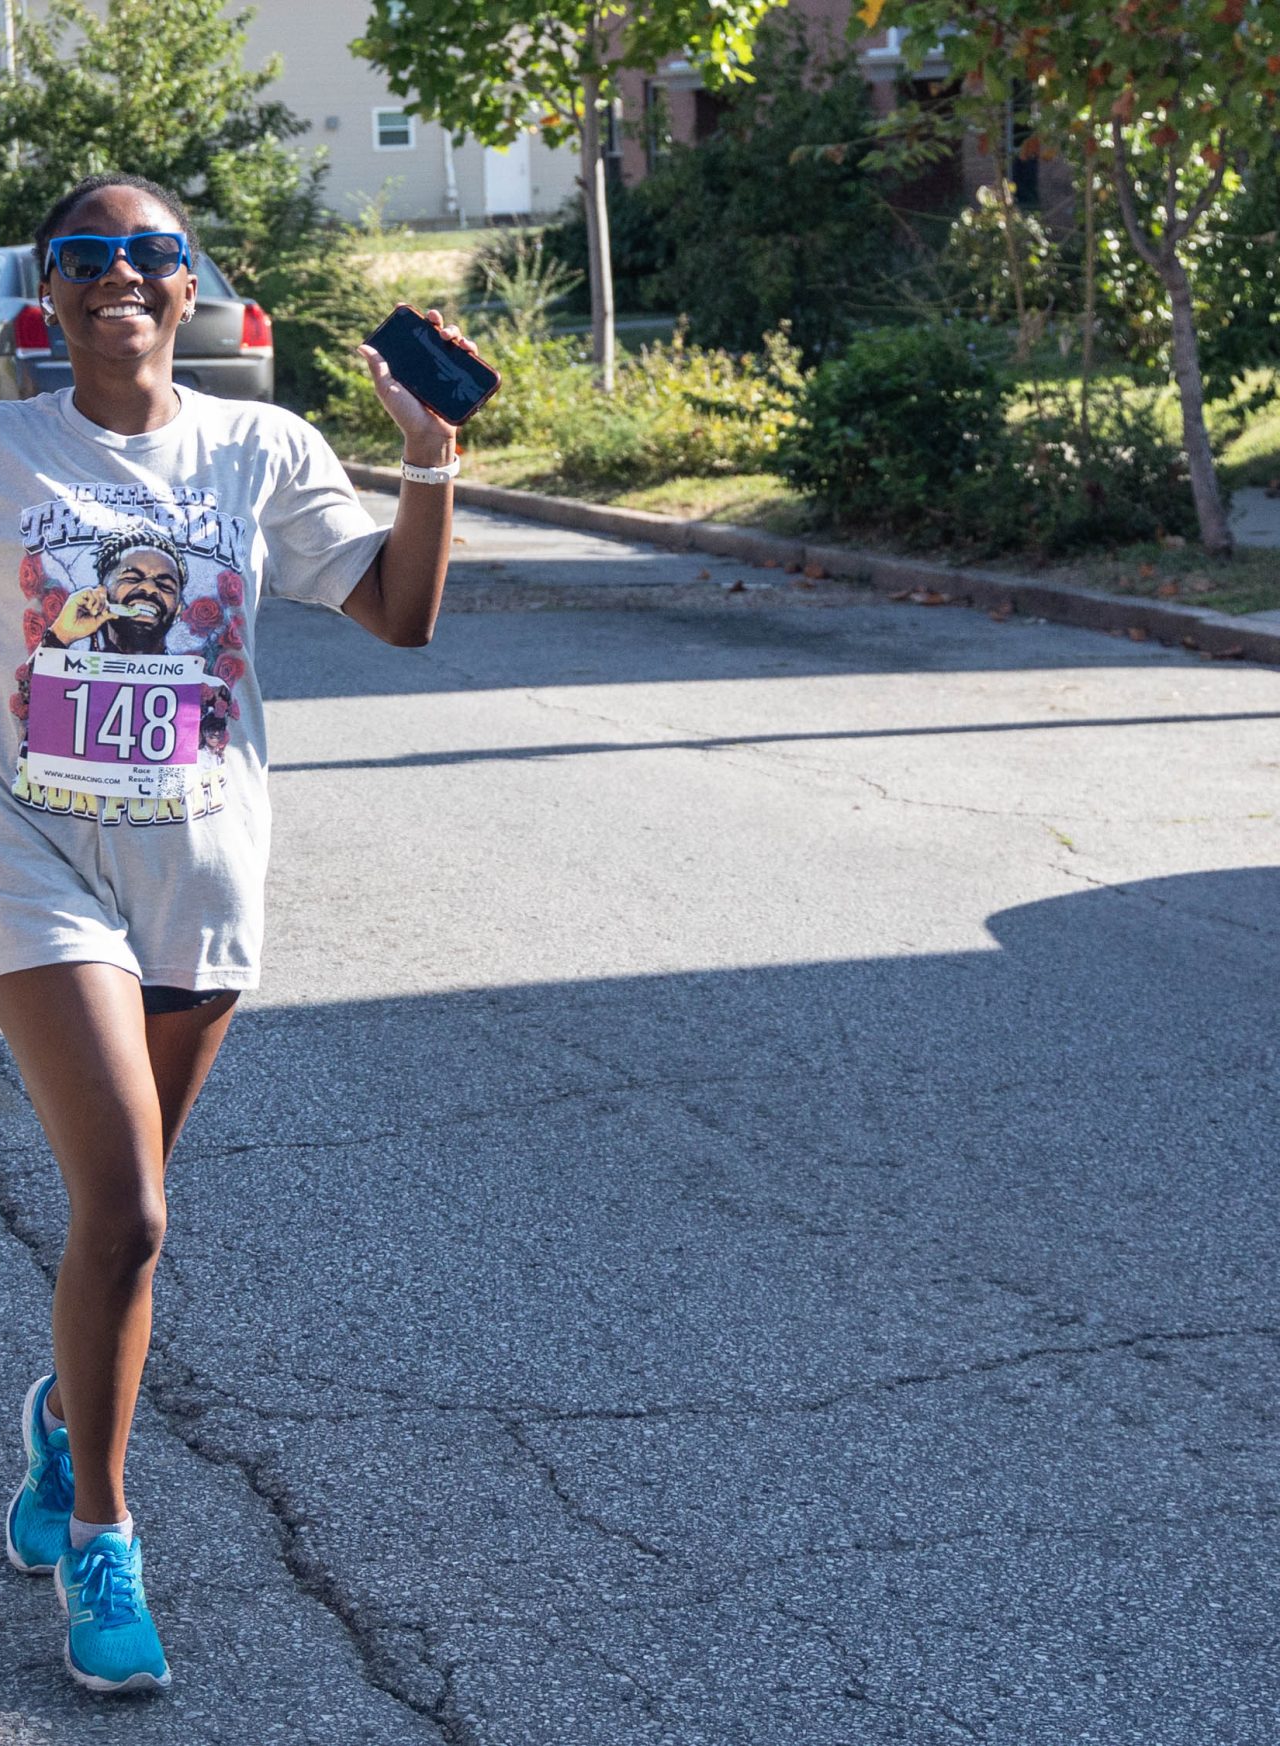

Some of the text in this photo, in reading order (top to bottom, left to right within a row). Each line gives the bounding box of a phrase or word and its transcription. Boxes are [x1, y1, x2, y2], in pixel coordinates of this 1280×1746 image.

[126, 662, 184, 676] RACING
[64, 682, 179, 762] 148
[132, 766, 151, 775] Race
[128, 775, 154, 784] Results
